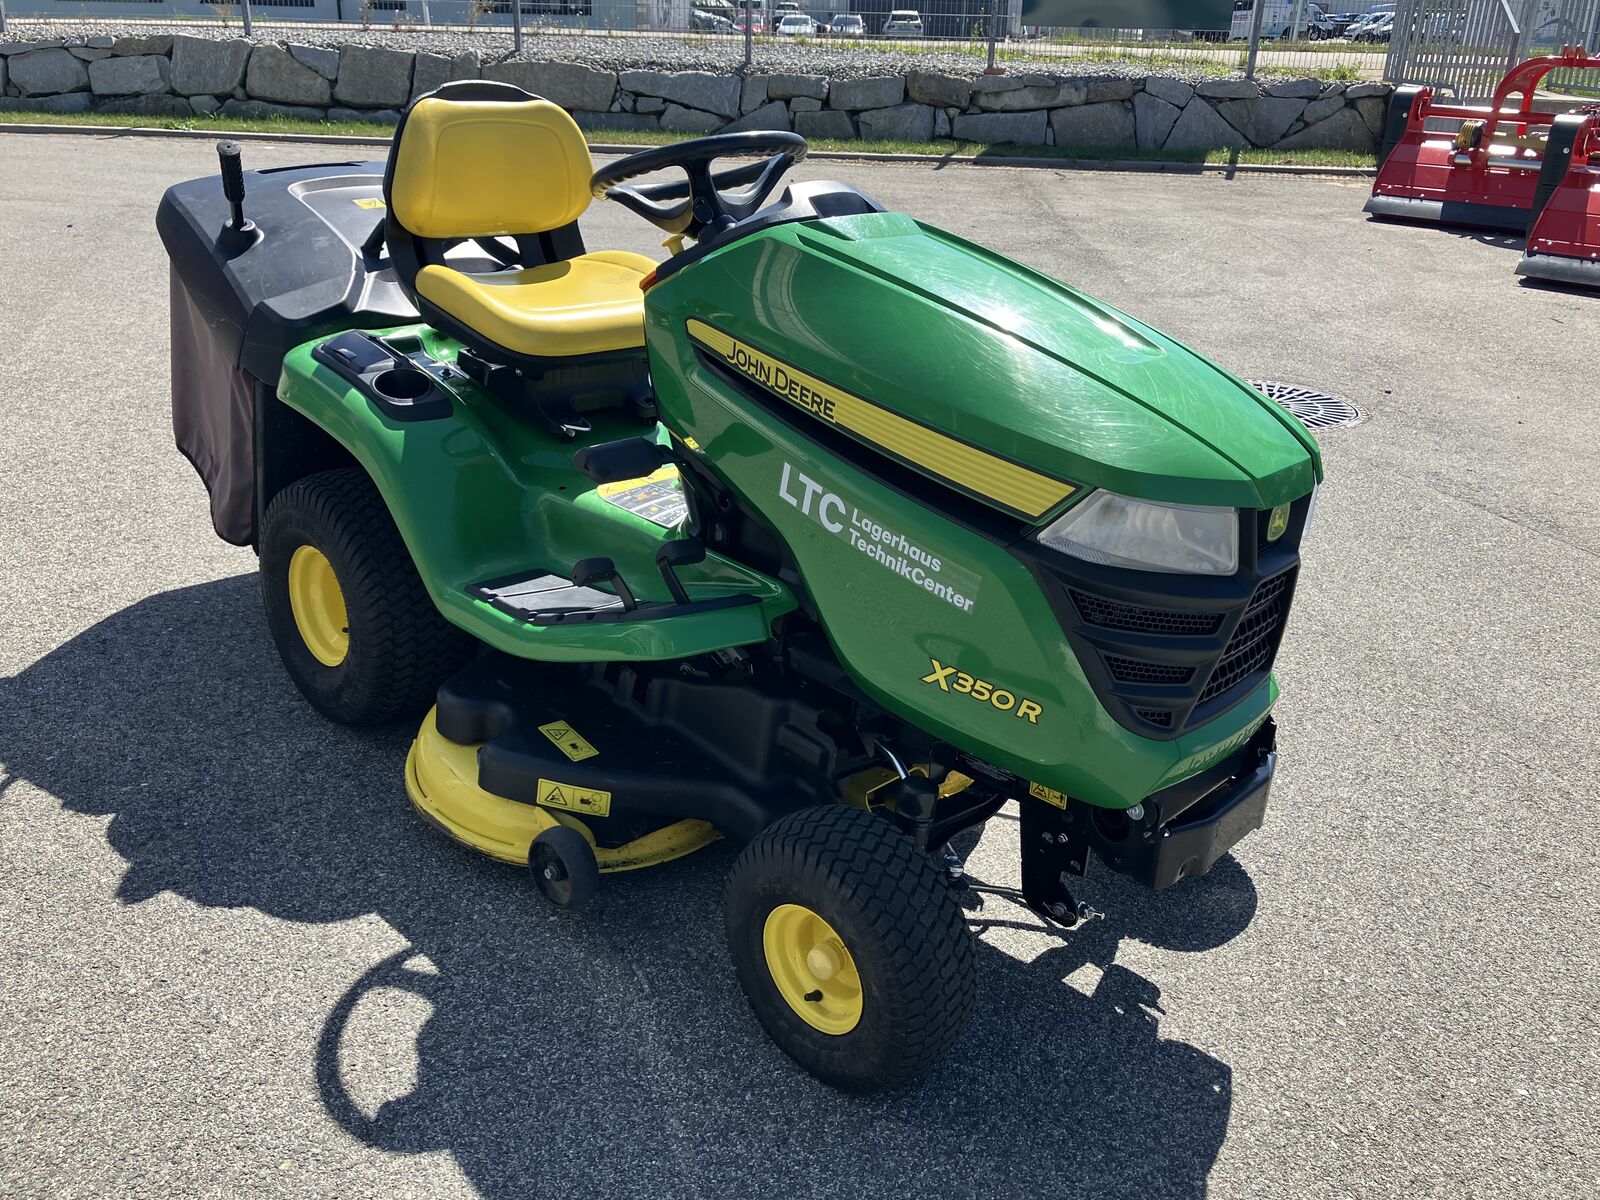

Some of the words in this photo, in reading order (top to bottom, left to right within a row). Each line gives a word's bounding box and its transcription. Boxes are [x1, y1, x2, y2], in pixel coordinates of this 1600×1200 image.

[726, 342, 771, 384] JOHN
[774, 366, 836, 420] DEERE
[778, 462, 847, 534] LTC
[848, 528, 974, 612] TechnikCenter
[851, 508, 942, 572] Lagerhaus
